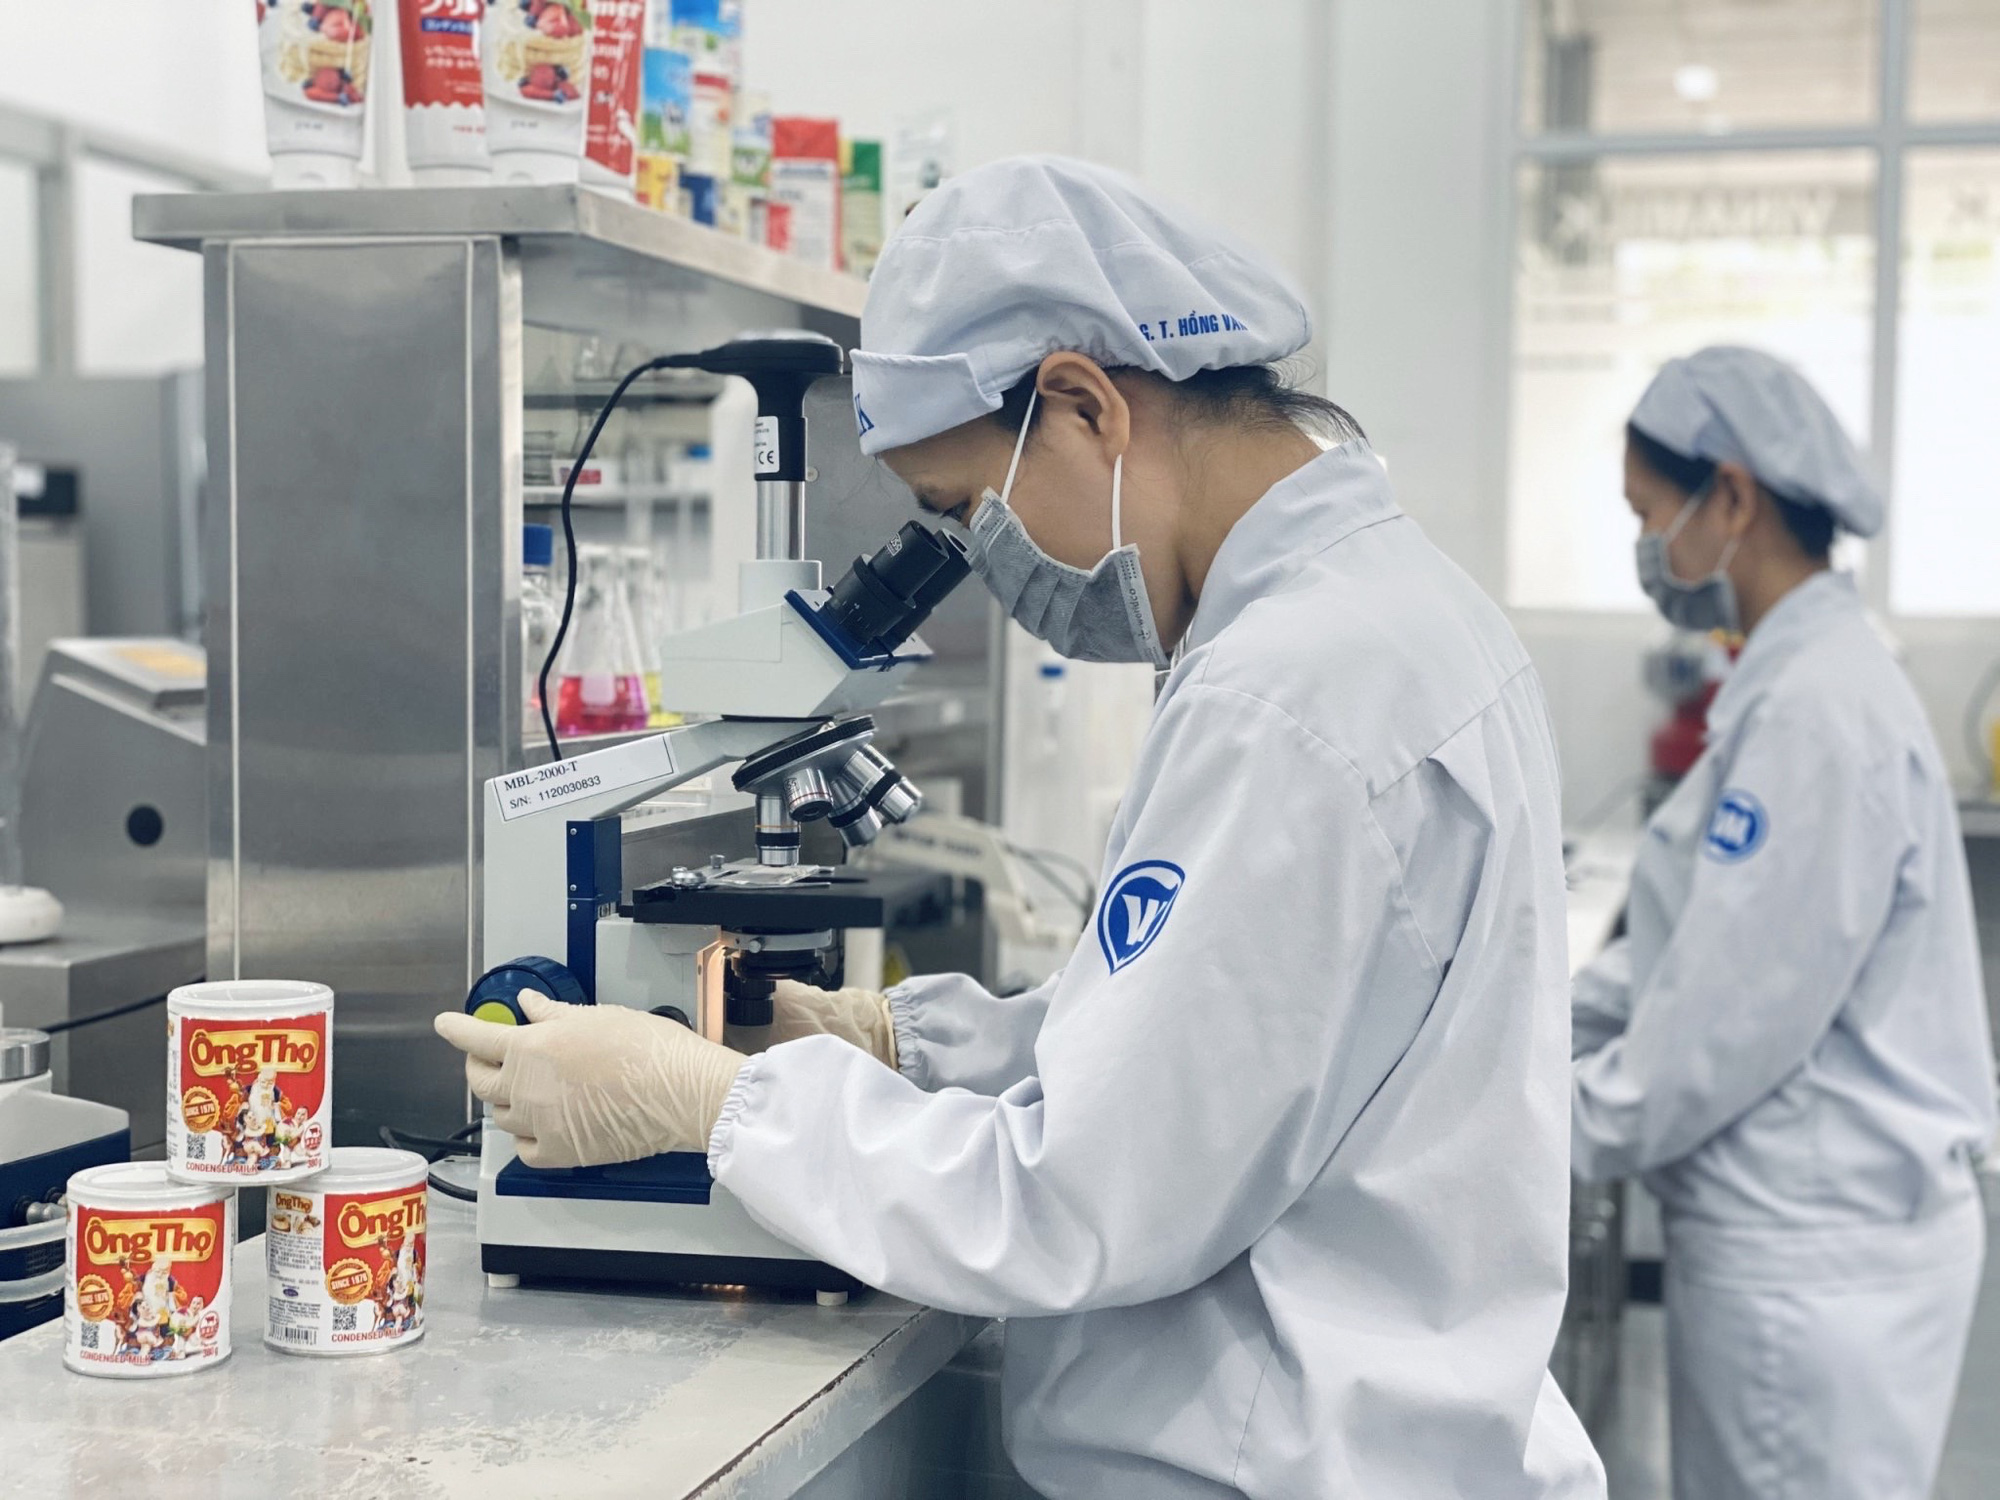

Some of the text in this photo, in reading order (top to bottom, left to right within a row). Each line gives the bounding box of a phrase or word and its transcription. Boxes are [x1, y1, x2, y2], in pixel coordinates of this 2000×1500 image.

[1158, 320, 1174, 339] T.
[1178, 310, 1220, 337] HỒNG
[504, 761, 577, 791] MBL-2000-T
[510, 775, 601, 809] S/N: 1120030833
[186, 1161, 236, 1173] CONDENSED
[331, 1331, 383, 1342] CONDENSED
